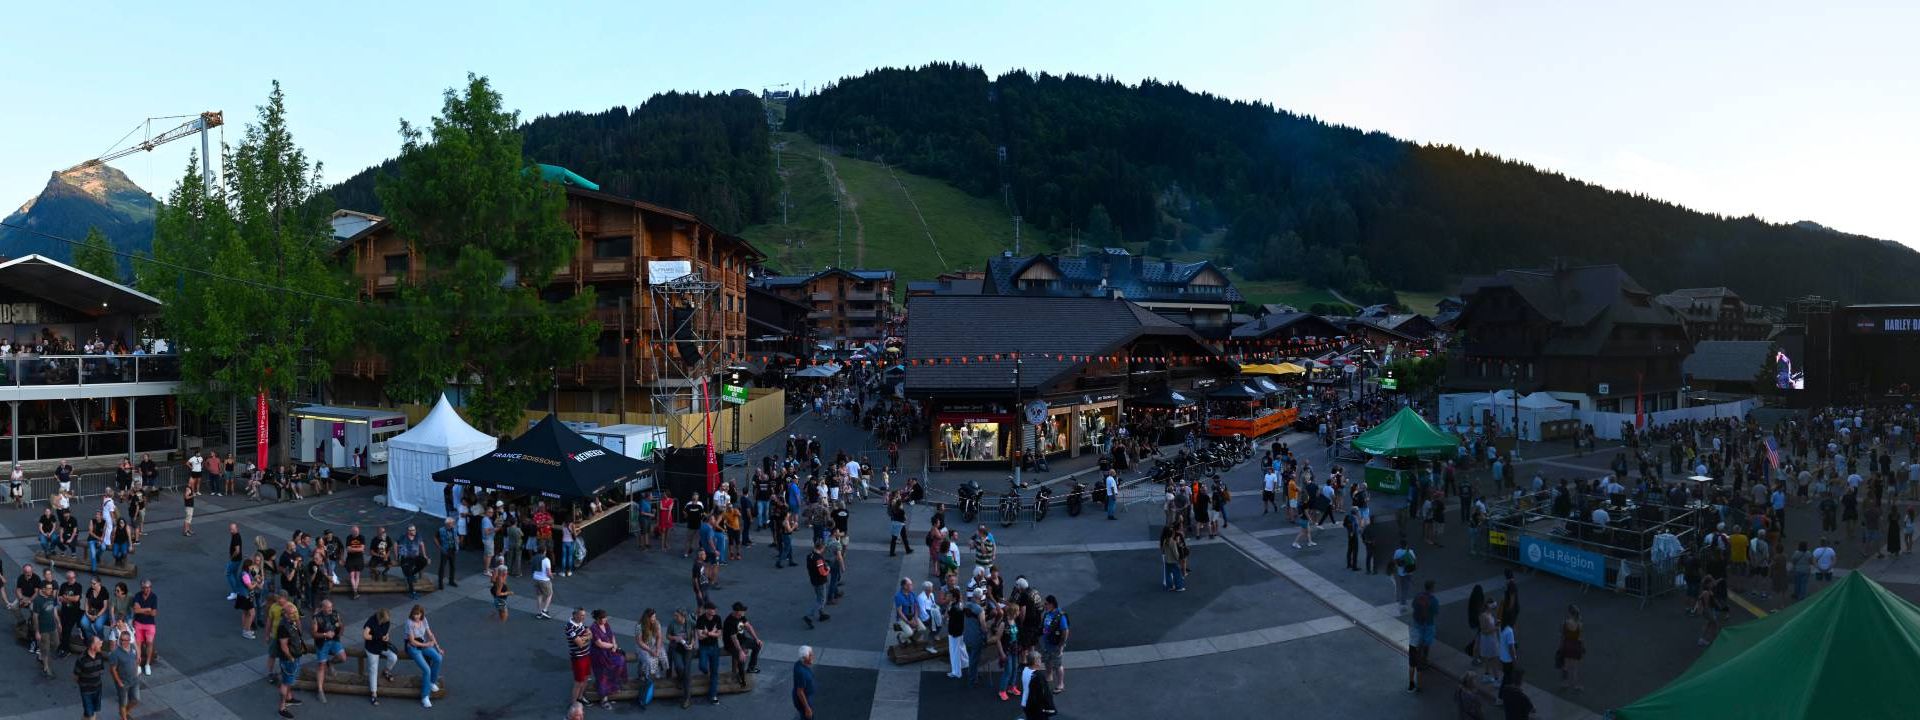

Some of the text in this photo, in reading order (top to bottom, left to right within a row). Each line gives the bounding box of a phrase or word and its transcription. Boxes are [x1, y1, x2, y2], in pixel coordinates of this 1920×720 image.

[1884, 319, 1910, 330] HARLEY
[1543, 545, 1555, 559] La
[1557, 549, 1595, 570] Région
